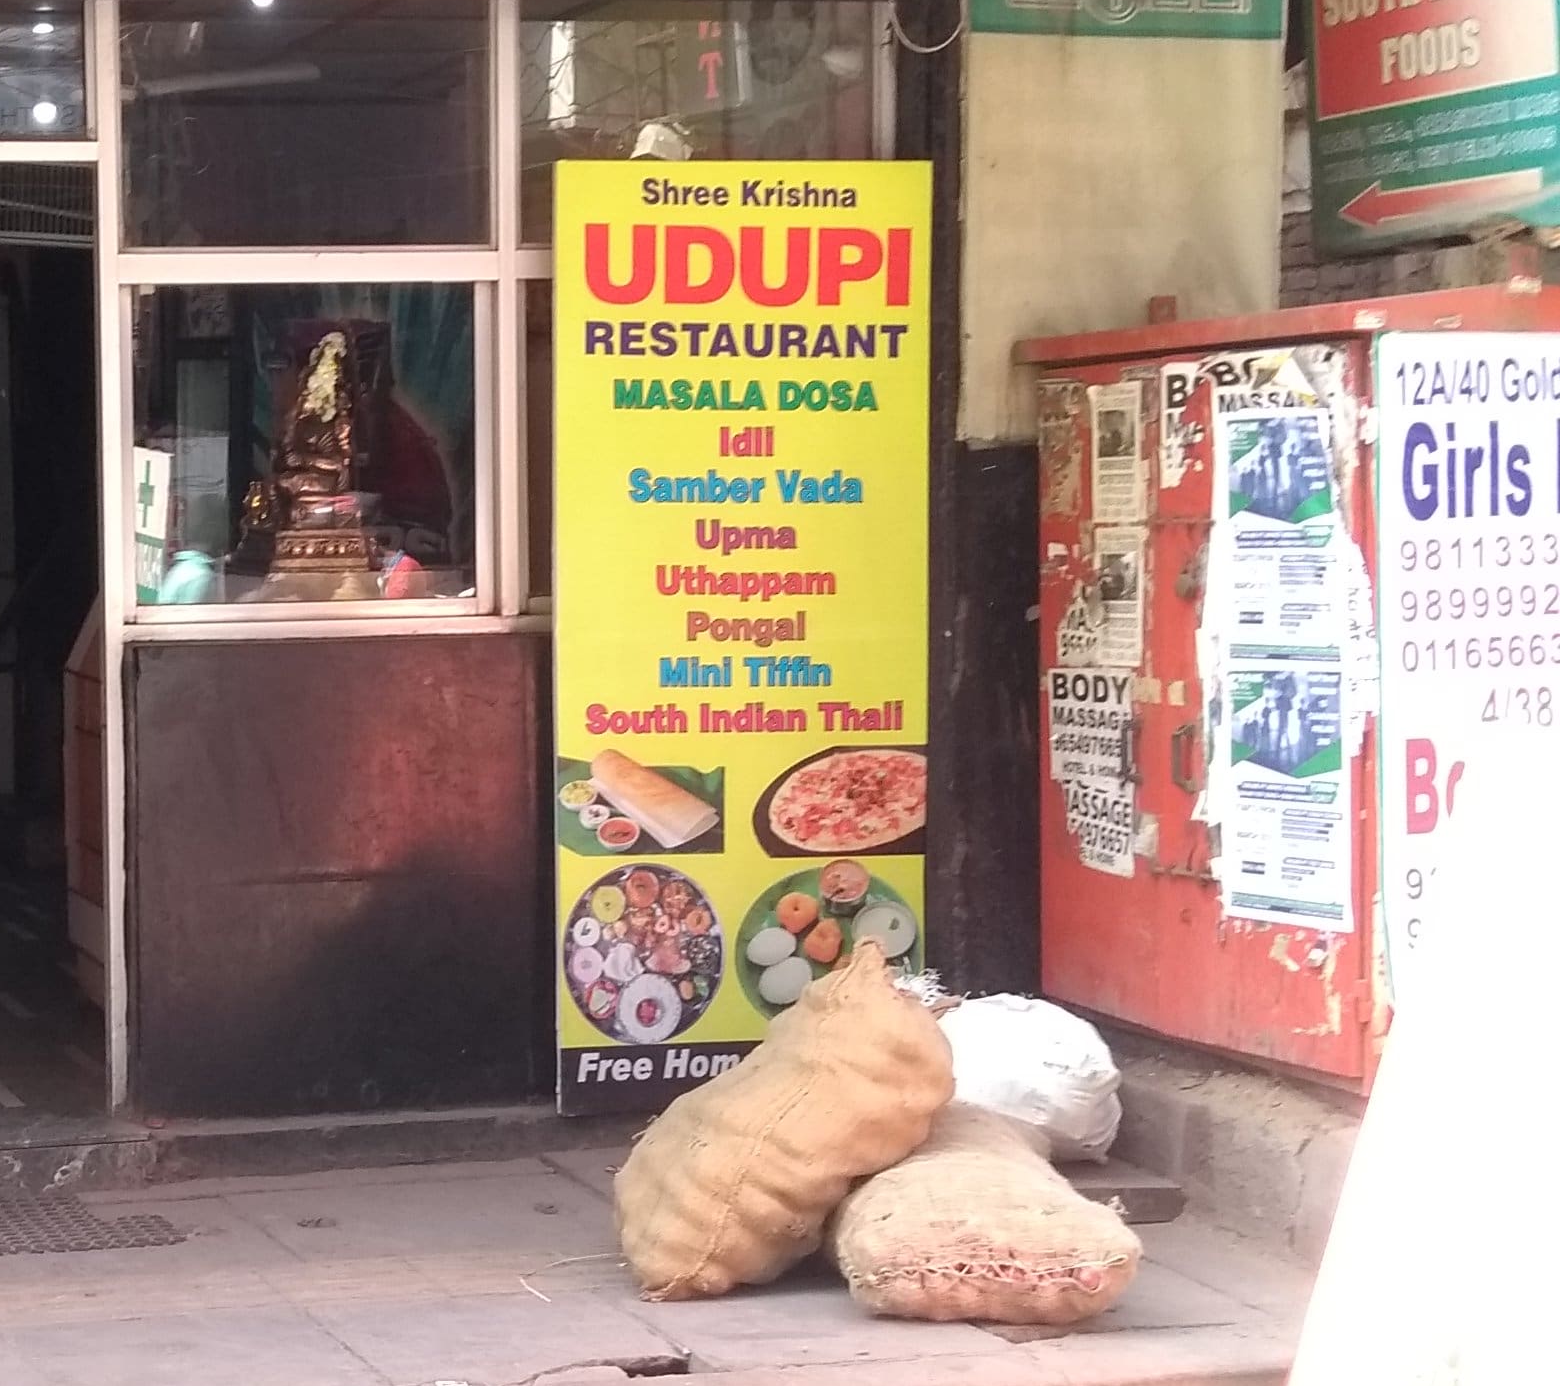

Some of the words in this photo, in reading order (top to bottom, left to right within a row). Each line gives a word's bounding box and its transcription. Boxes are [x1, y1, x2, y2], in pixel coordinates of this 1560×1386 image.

[1380, 18, 1481, 85] FOODS
[640, 178, 730, 207] Shree
[740, 180, 858, 208] Krishna
[583, 221, 911, 307] UDUPI
[583, 321, 909, 359] RESTAURANT
[612, 378, 766, 412] MASALA
[778, 379, 878, 412] DOSA
[1397, 358, 1490, 405] 12A/40
[719, 426, 774, 457] Idli
[627, 467, 765, 504] Samber
[776, 469, 864, 504] Vada
[1403, 420, 1532, 522] Girls
[694, 519, 797, 556] Upma
[1400, 533, 1560, 572] 9811333
[655, 564, 836, 601] Uthappam
[1401, 584, 1560, 623] 9899992
[686, 611, 806, 647] Pongal
[659, 656, 731, 688] Mini
[742, 657, 832, 688] Tiffin
[1052, 673, 1128, 705] BODY
[585, 703, 687, 735] South
[698, 702, 806, 733] Indian
[817, 699, 904, 733] Thali
[577, 1051, 654, 1083] Free
